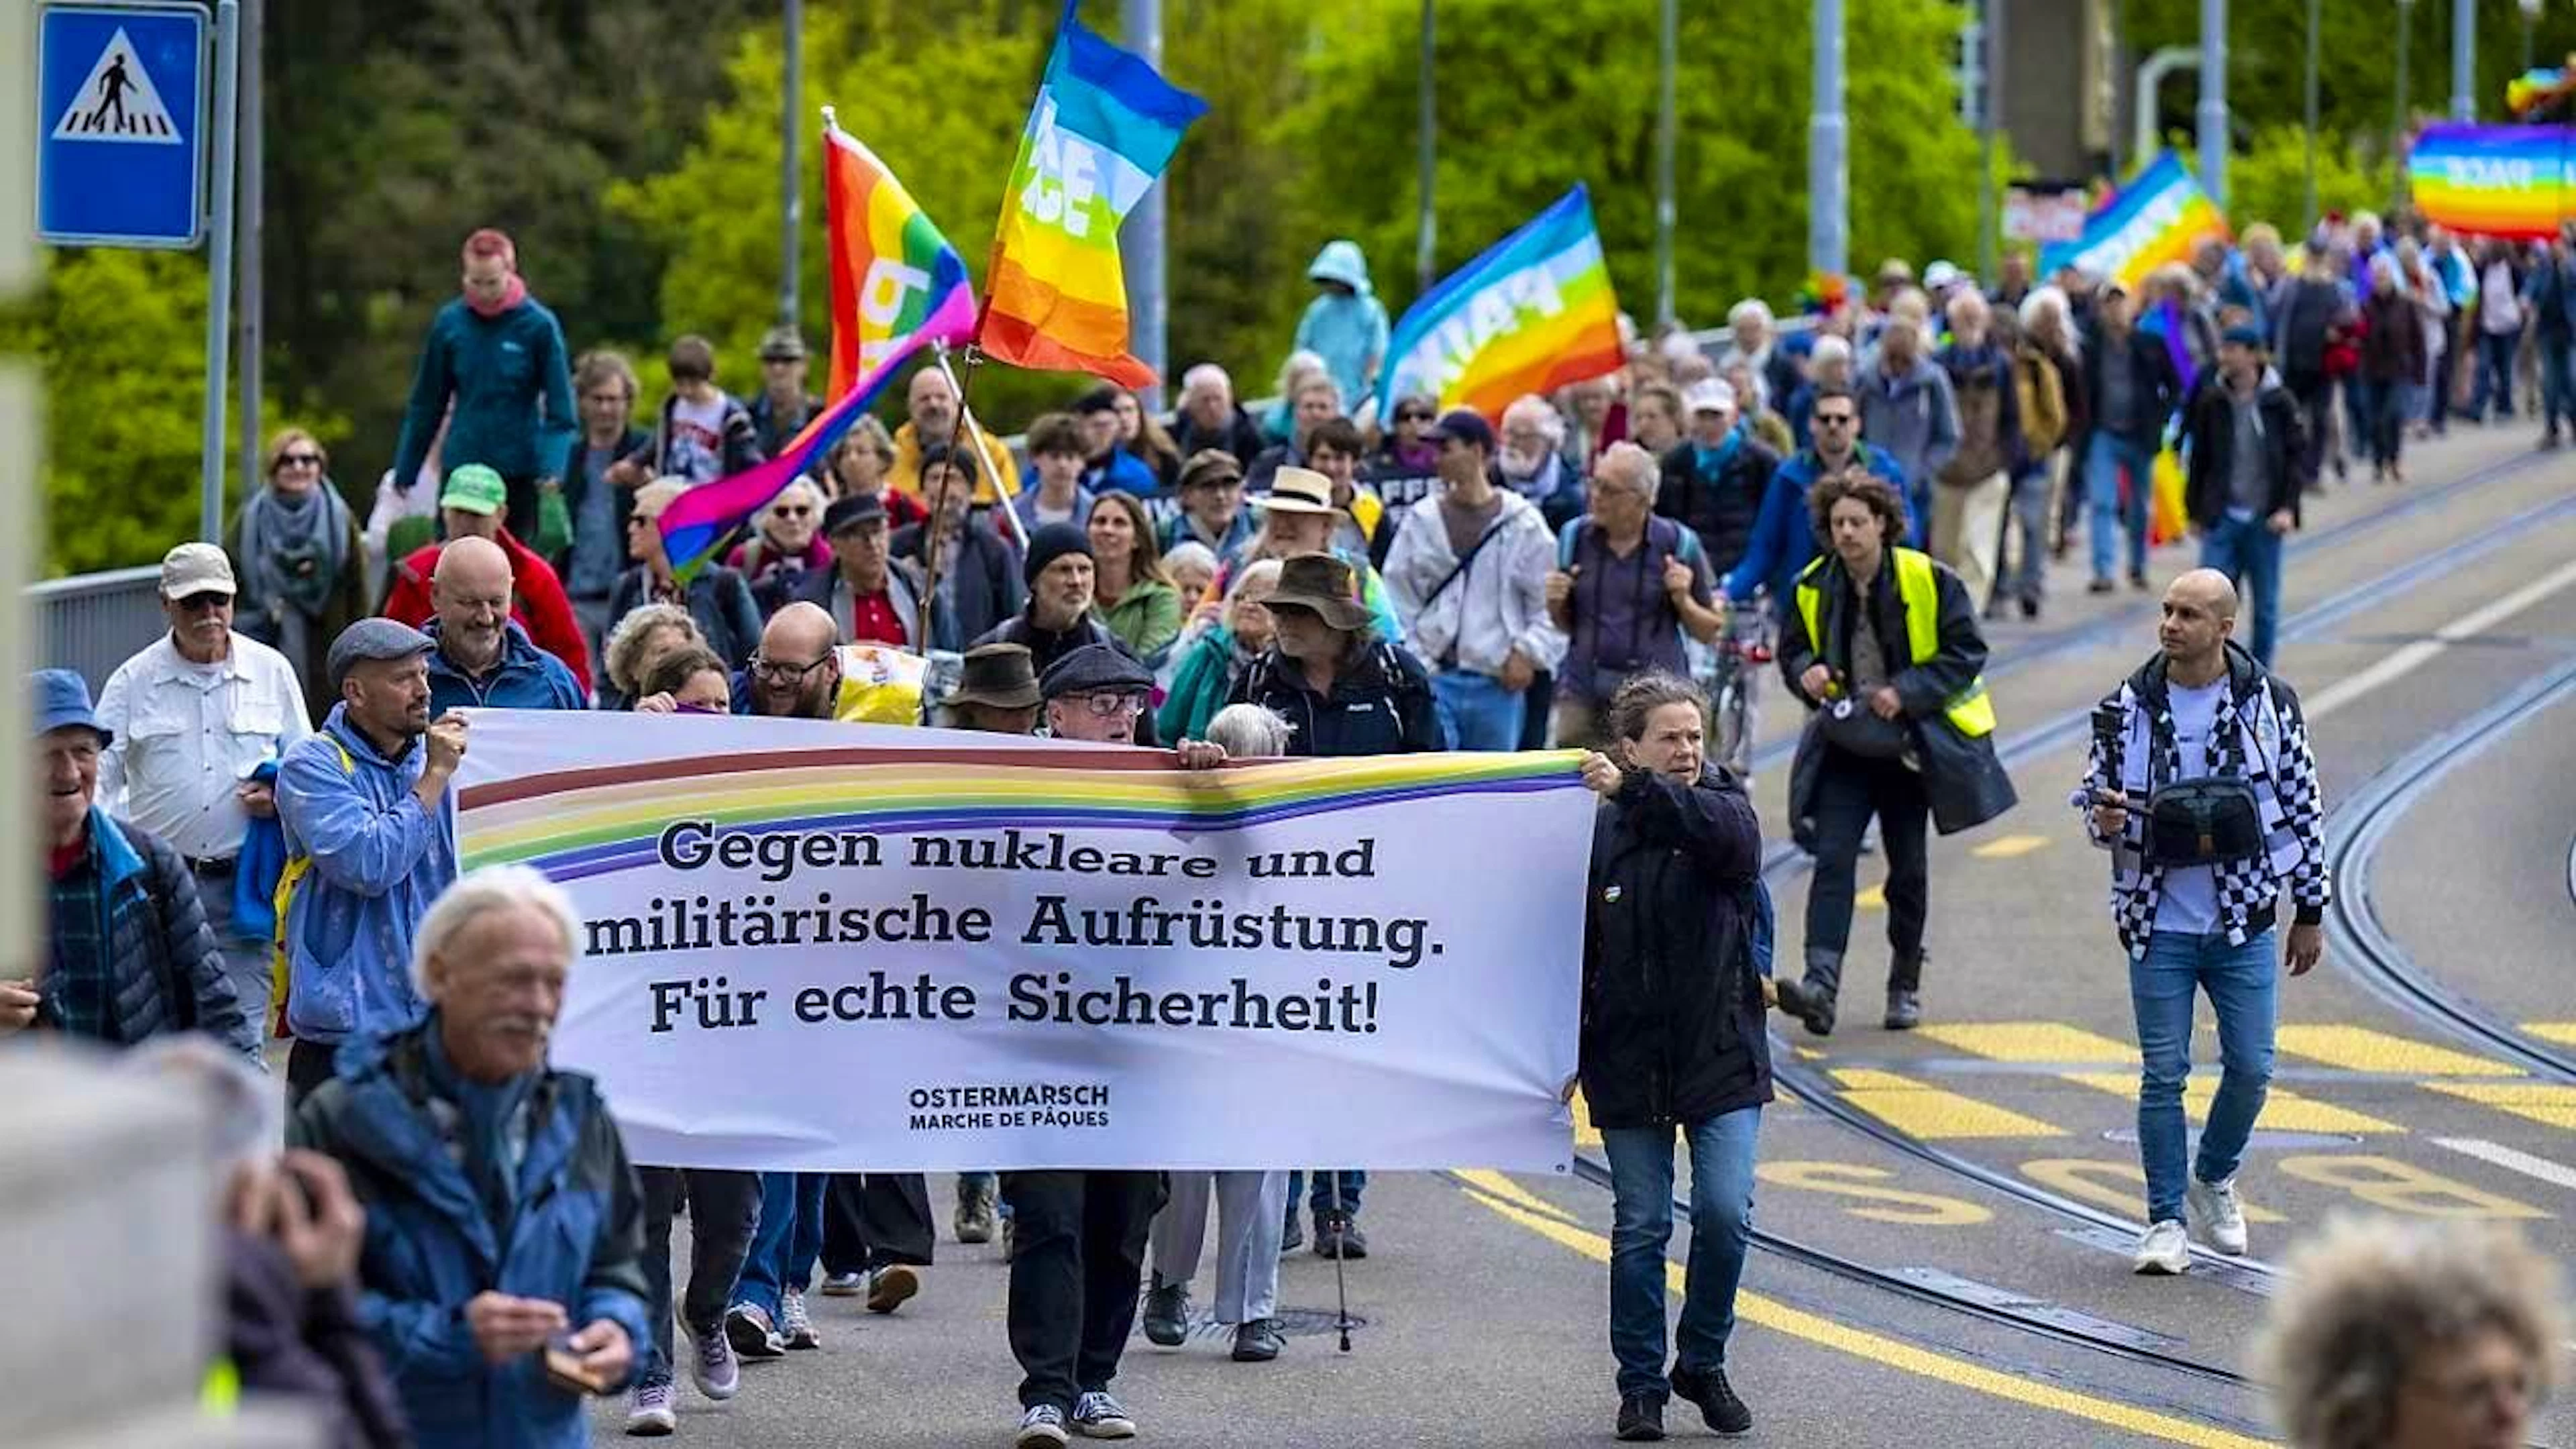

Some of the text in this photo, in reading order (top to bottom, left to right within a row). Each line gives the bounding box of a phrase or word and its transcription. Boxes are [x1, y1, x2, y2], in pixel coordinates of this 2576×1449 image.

[661, 822, 1374, 881] Gegen nukleare und
[584, 892, 1443, 968] militärische Aufrüstung.
[650, 971, 1377, 1032] Für echte Sicherheit!
[910, 1085, 1108, 1108] OSTERMARSCH
[910, 1106, 1109, 1130] MARCHE DE PÂQUES
